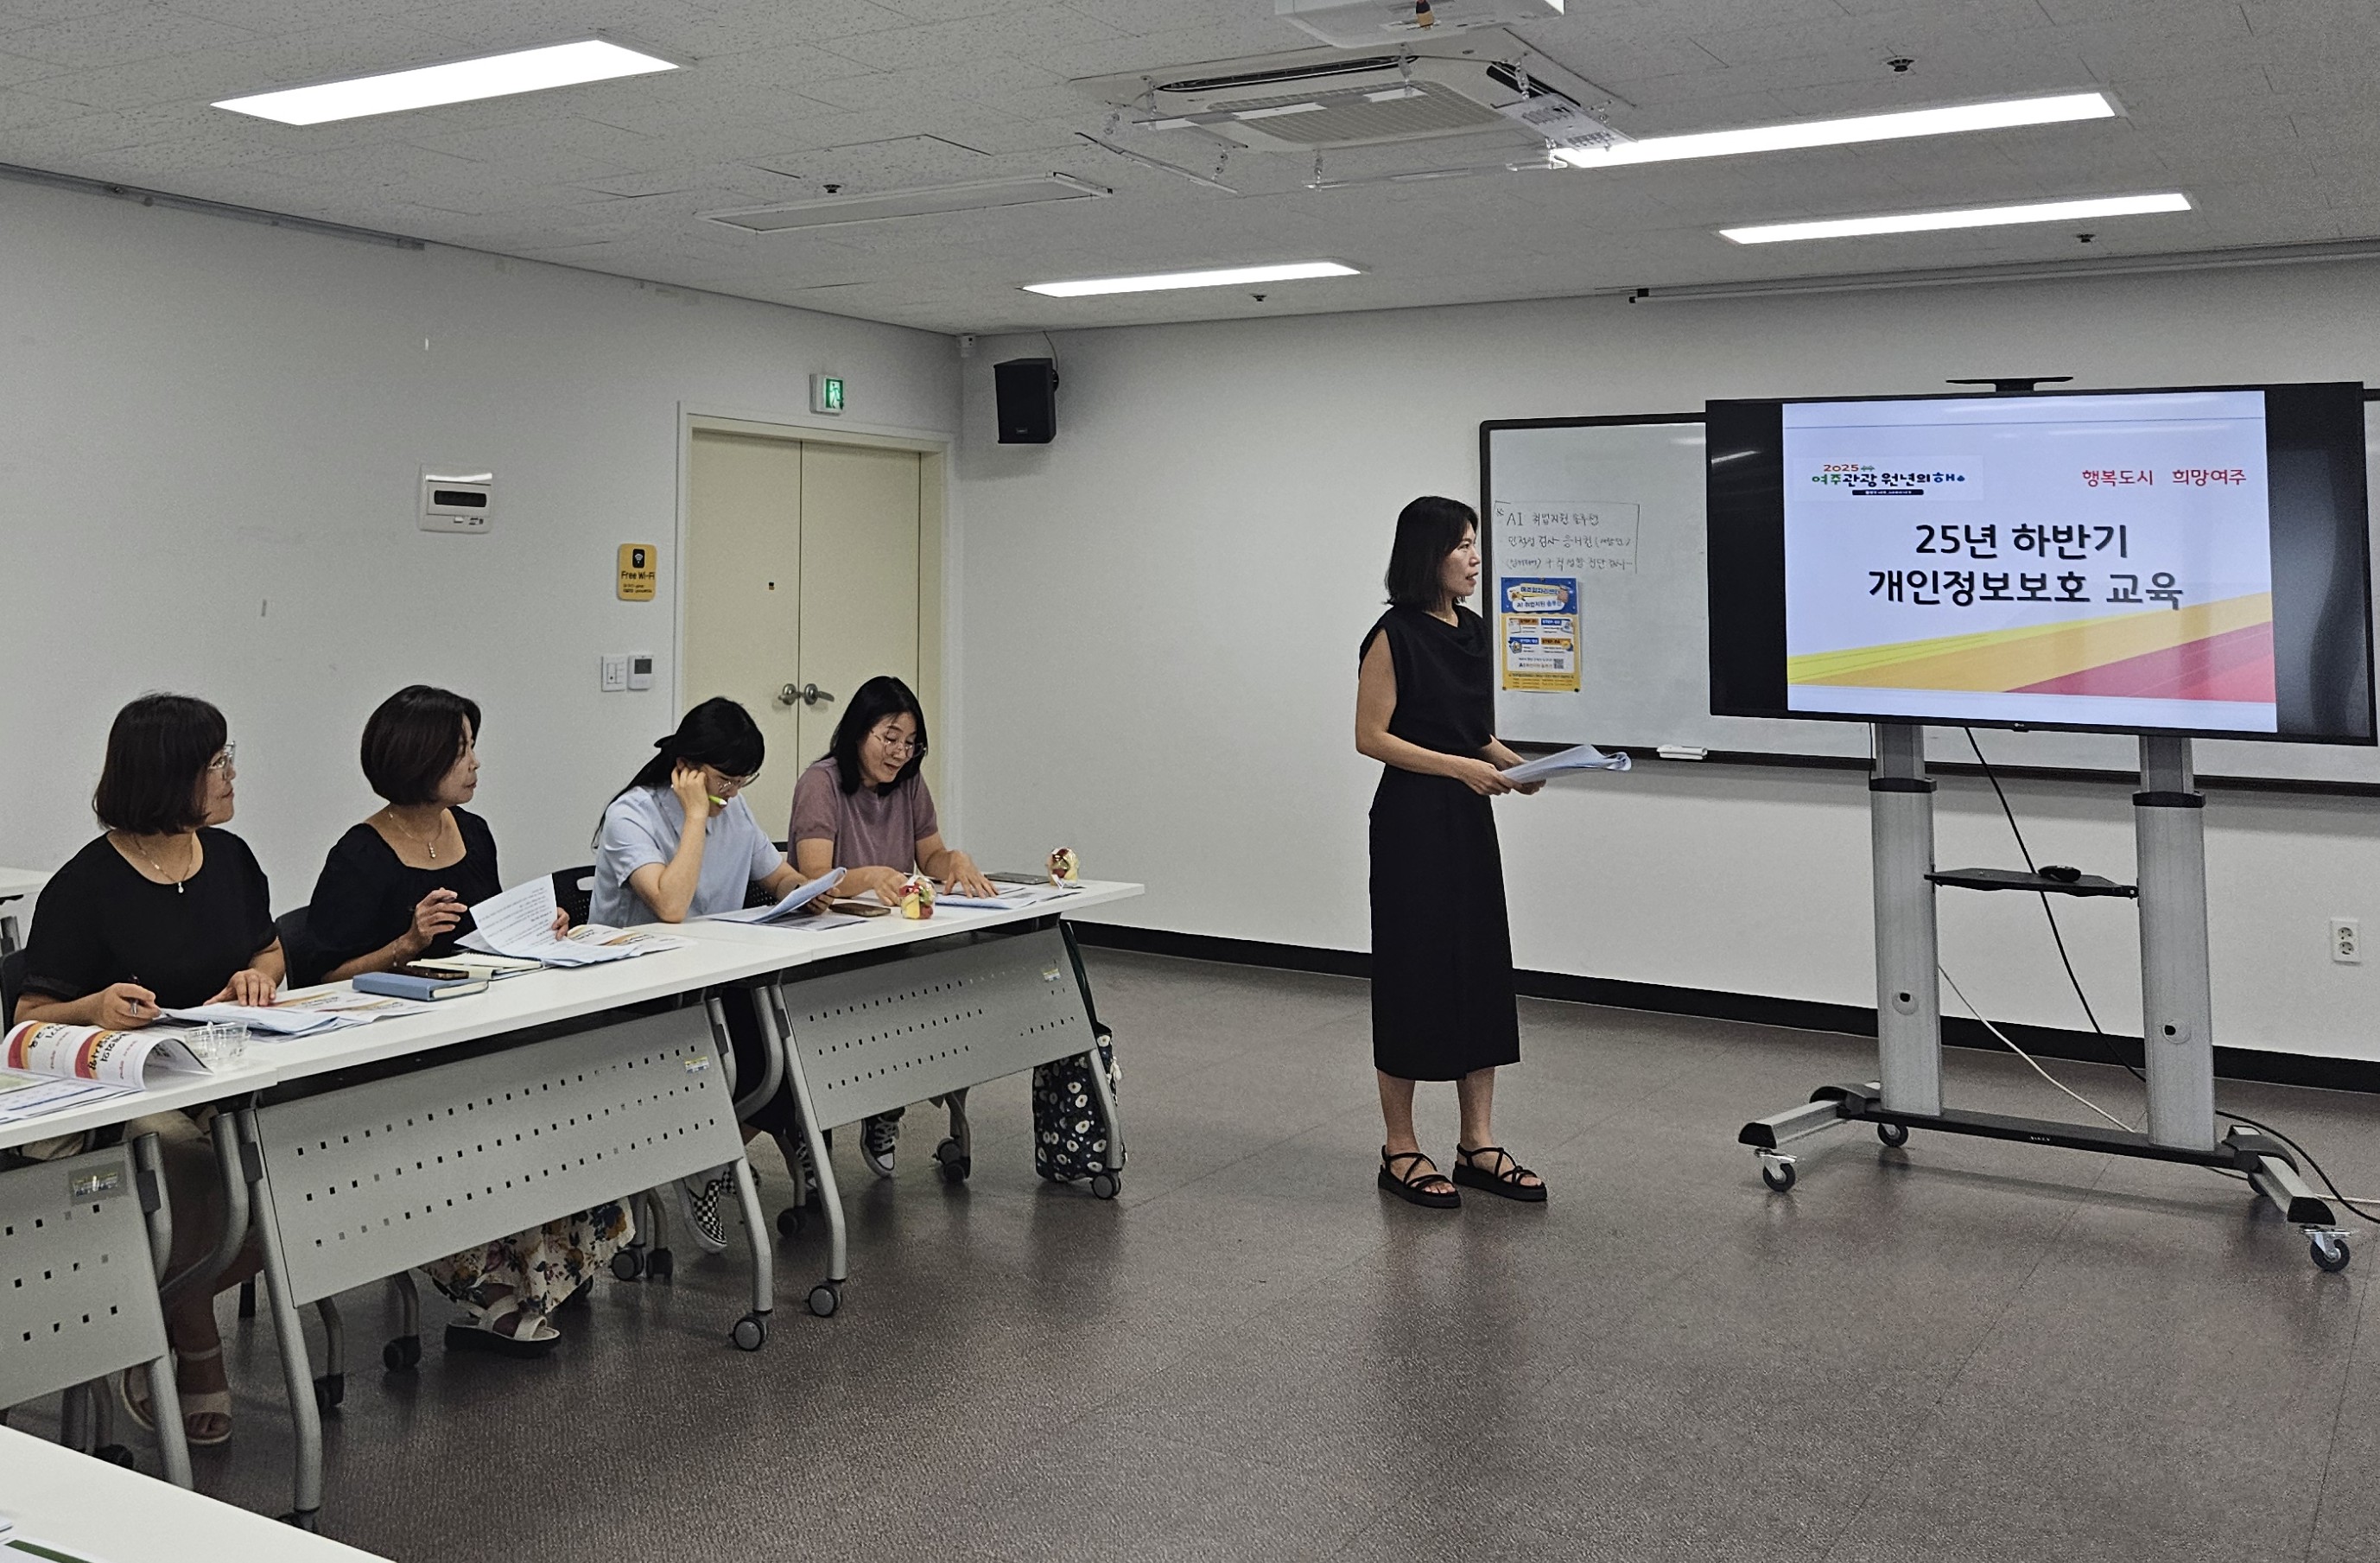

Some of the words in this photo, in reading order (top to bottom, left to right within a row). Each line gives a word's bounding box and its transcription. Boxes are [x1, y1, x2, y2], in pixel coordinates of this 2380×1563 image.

[1823, 463, 1859, 473] 2025
[1812, 473, 1877, 487] 여주관광
[2082, 469, 2154, 487] 행복도시
[2172, 469, 2247, 486] 희망여주
[1506, 511, 1523, 526] AI
[1915, 524, 1997, 559] 25년
[2011, 523, 2129, 561] 하반기
[621, 570, 638, 580] Free
[638, 571, 656, 581] Wi-Fi
[1868, 569, 2091, 607] 개인정보보호
[2105, 571, 2184, 611] 교육
